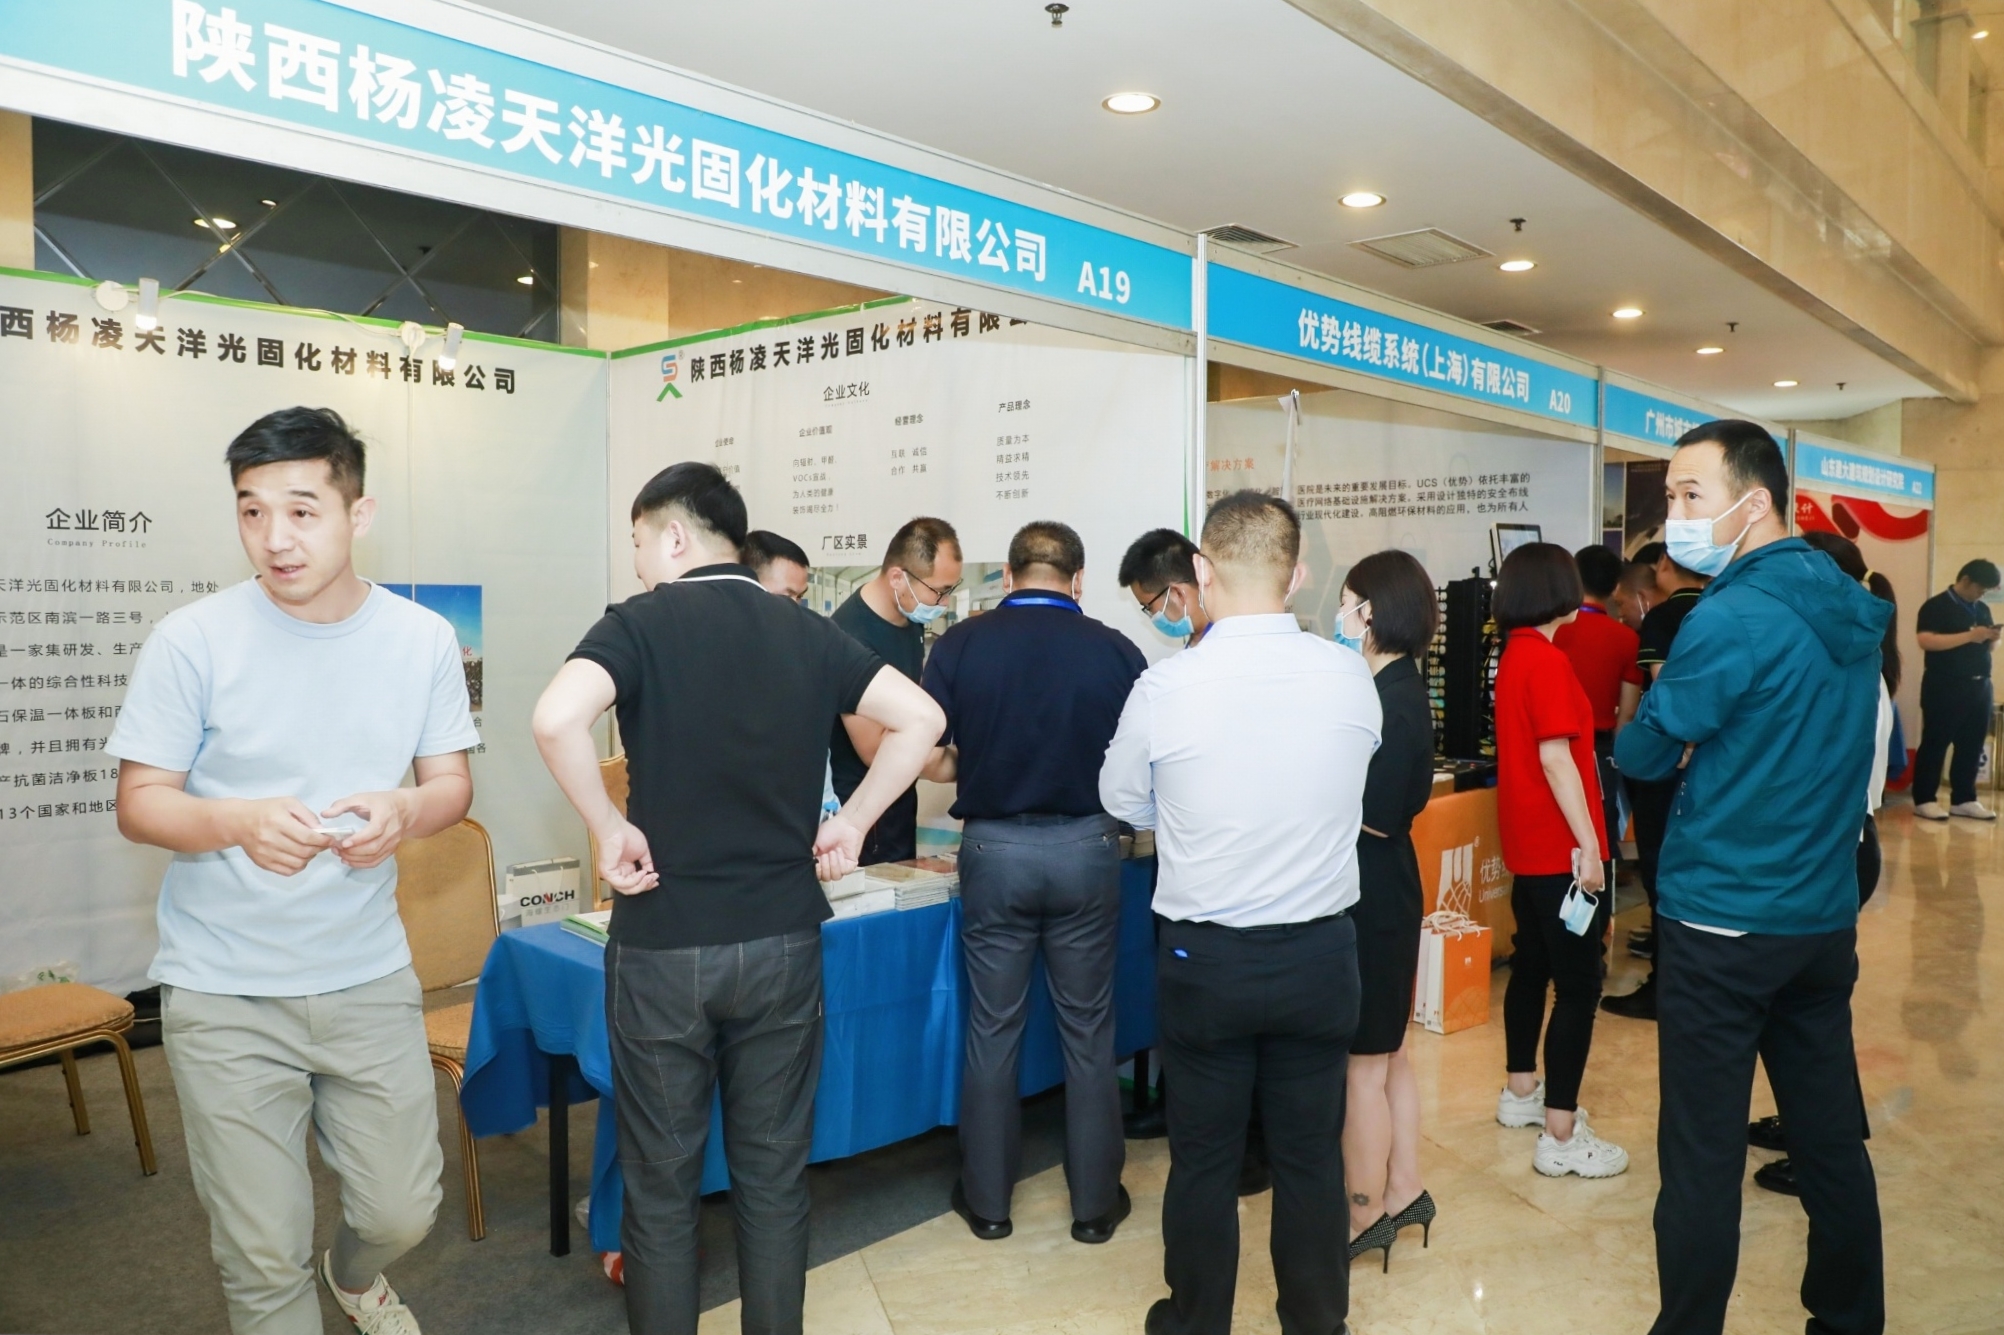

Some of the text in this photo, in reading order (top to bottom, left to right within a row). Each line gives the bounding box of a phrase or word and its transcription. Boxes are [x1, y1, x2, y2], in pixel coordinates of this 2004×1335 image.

[172, 0, 1132, 304] 陕西杨凌天洋光固化材料有限公司 A19
[0, 305, 515, 394] 西杨凌天洋光固化材料有限公司
[690, 307, 1028, 384] 陕西杨凌天洋光固化材料有限
[823, 381, 870, 402] 企业文化
[998, 398, 1031, 413] 产品理念
[1549, 389, 1571, 415] A20
[894, 413, 924, 427] 经营理念
[996, 433, 1030, 447] 质量为本
[995, 470, 1030, 483] 技术领先
[995, 488, 1030, 501] 不断创新
[45, 507, 152, 534] 企业简介
[47, 538, 147, 549] Company Profile
[821, 533, 868, 551] 厂区实景
[520, 890, 575, 907] CONCH
